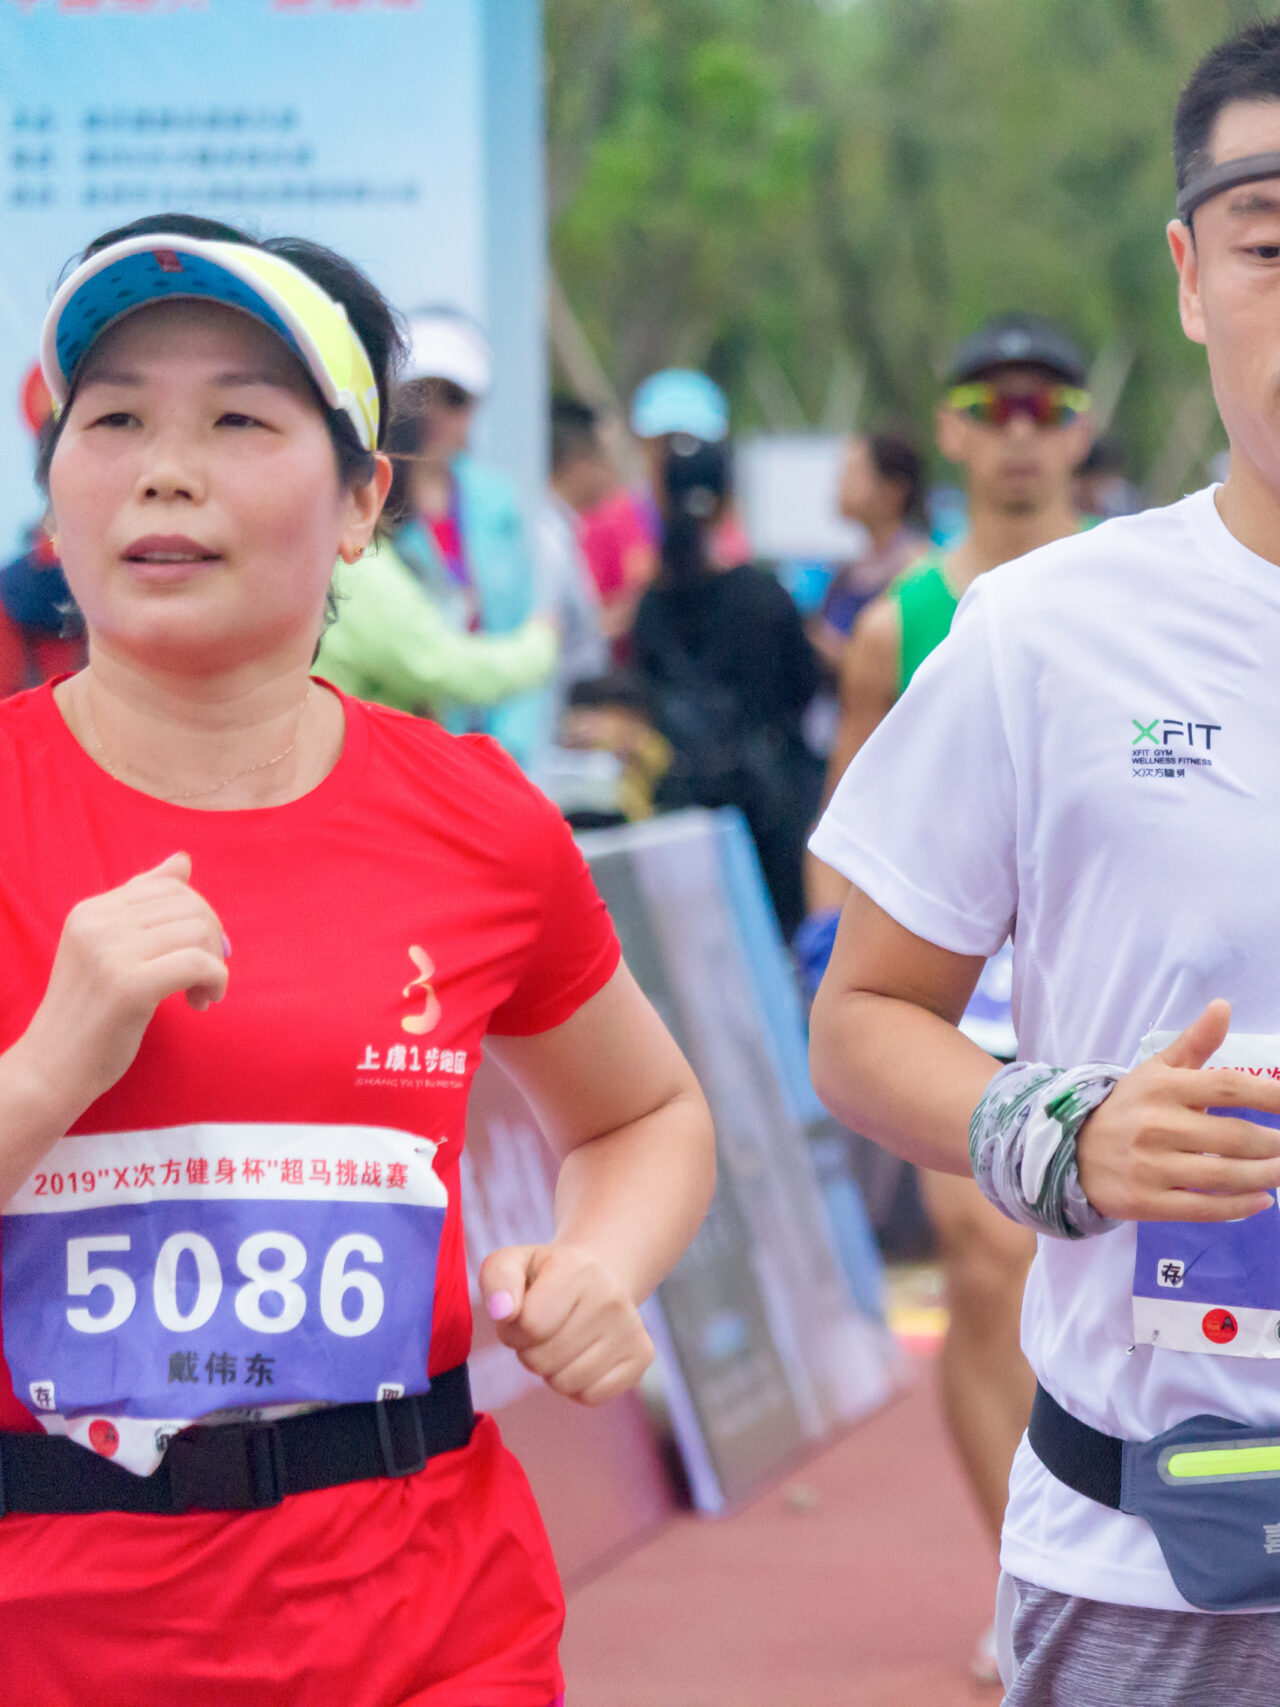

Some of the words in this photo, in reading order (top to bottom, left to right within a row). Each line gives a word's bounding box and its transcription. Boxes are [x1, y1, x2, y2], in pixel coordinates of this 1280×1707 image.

[1132, 718, 1222, 750] XFIT
[1132, 757, 1176, 765] WELLNESS
[1178, 757, 1212, 766] FITNESS
[66, 1231, 385, 1337] 5086
[1161, 1263, 1182, 1285] 存
[167, 1352, 276, 1386] 戴伟东
[34, 1386, 52, 1408] 存
